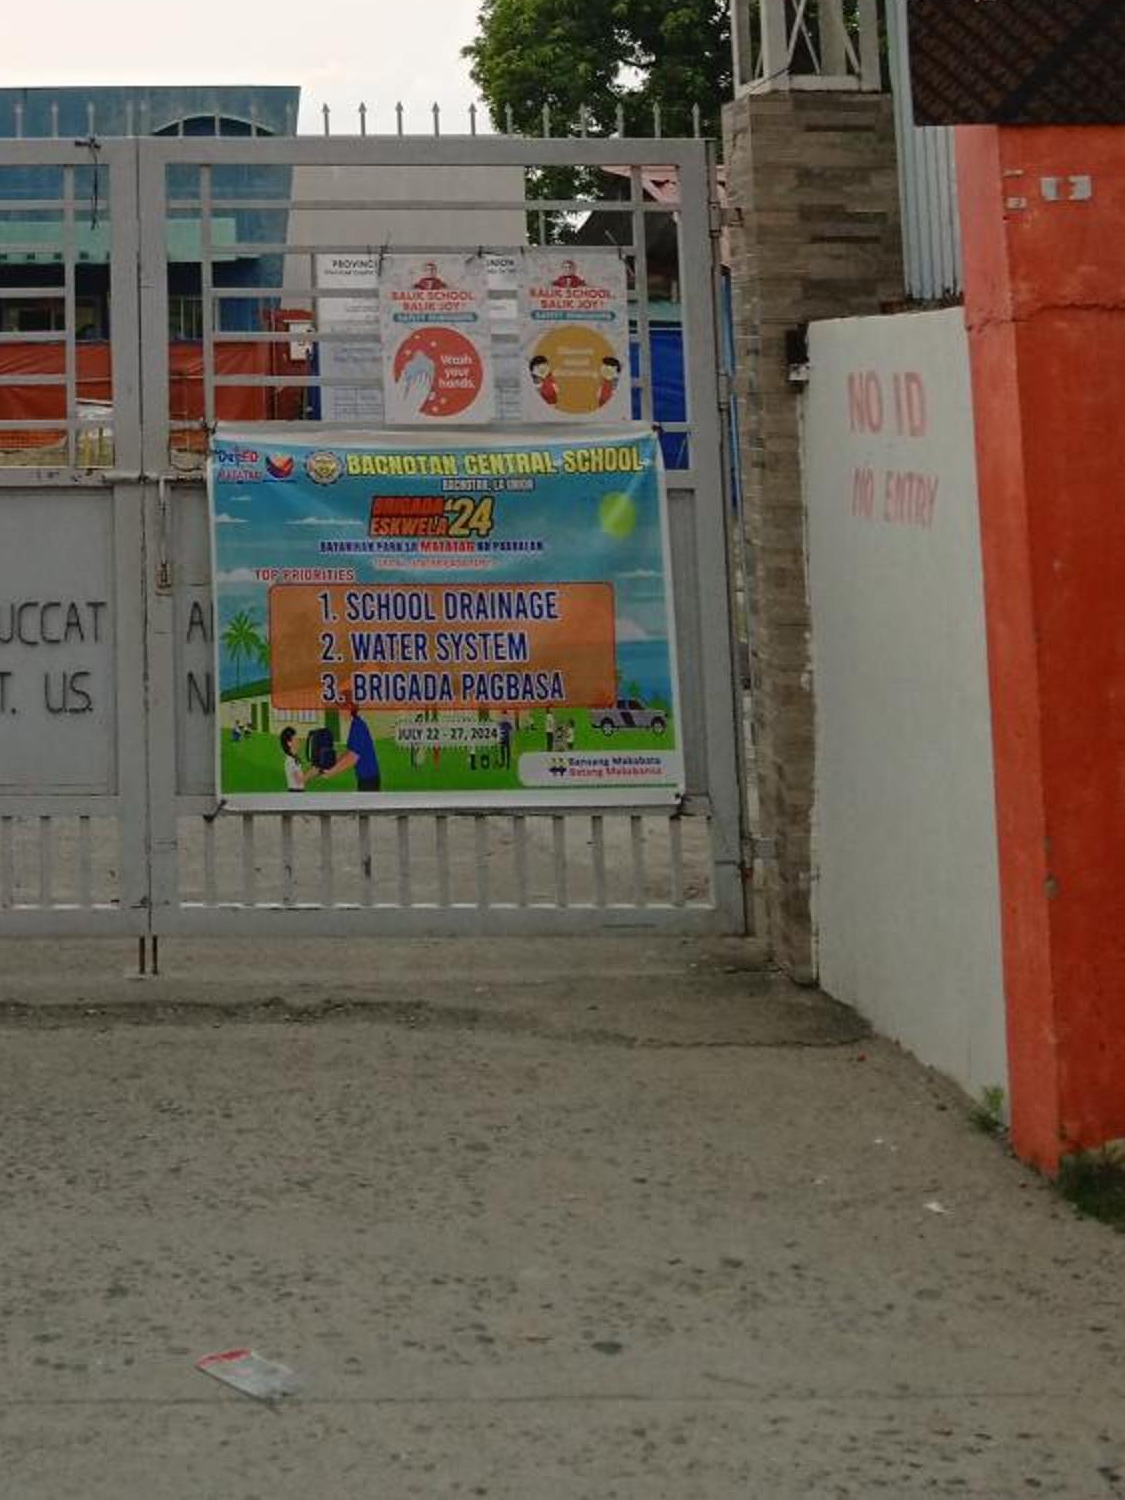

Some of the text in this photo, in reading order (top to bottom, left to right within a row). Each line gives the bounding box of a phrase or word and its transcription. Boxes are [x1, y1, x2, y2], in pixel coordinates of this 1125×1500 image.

[848, 371, 927, 437] NO ID
[347, 447, 644, 476] BACNOTAN CENTRAL SCHOOL
[884, 470, 939, 529] ENTRY
[370, 517, 449, 537] ESKWELA
[255, 569, 354, 581] TOP PRIORITIES
[319, 591, 558, 621] 1. SCHOOL DRAINAGE
[321, 631, 528, 661] 2. WATER SYSTEM
[322, 672, 564, 701] 3. BRIGADA PAGBASA
[398, 727, 422, 740] JULY
[426, 727, 440, 740] 22
